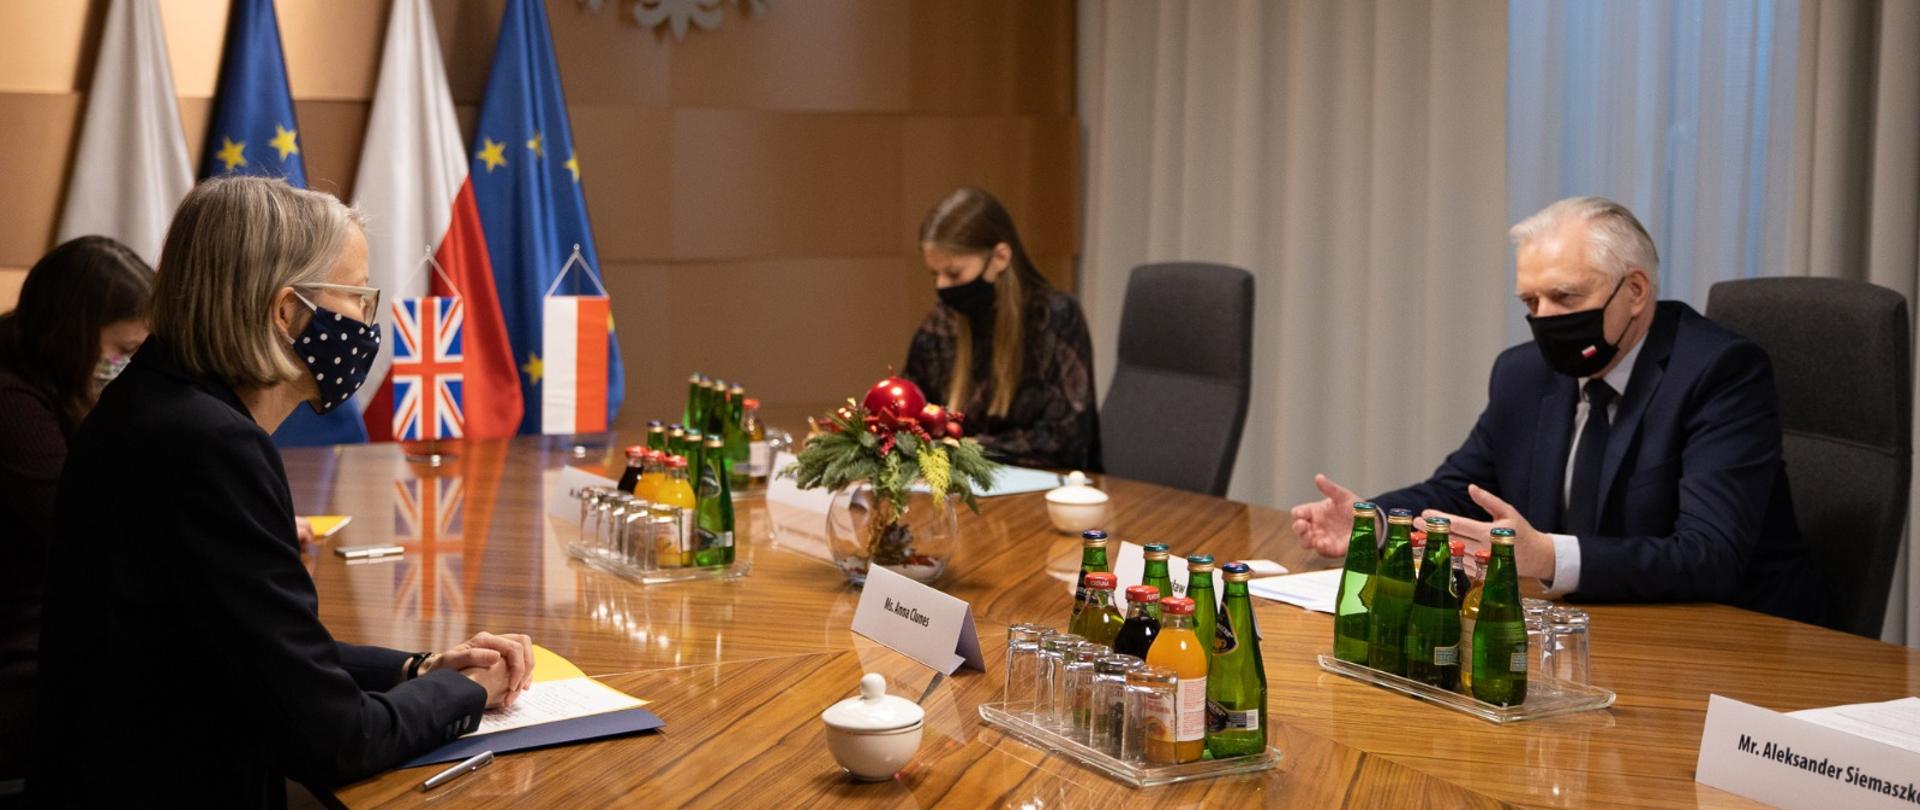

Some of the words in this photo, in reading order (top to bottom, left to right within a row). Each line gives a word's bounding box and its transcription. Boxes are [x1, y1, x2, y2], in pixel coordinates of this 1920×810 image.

[884, 597, 894, 612] Ms.
[895, 601, 910, 619] Anna
[910, 608, 930, 628] Clunes
[1738, 734, 1760, 756] Mr.
[1762, 741, 1842, 780] Aleksander
